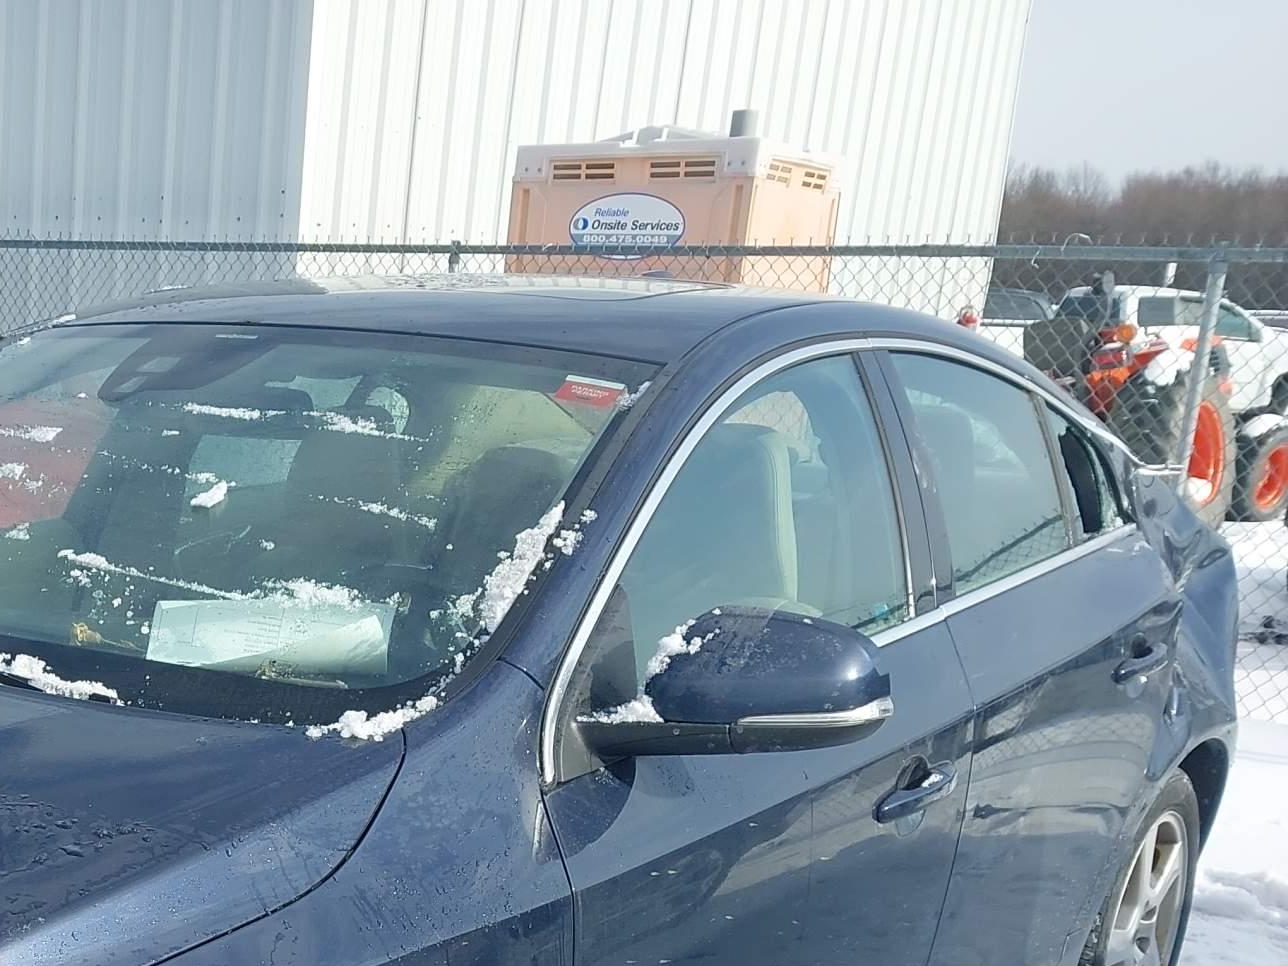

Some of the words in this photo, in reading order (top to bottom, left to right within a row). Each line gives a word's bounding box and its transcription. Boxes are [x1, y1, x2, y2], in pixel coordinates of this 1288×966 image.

[594, 207, 629, 217] Reliable
[592, 219, 627, 230] Onsite
[631, 219, 680, 231] Services
